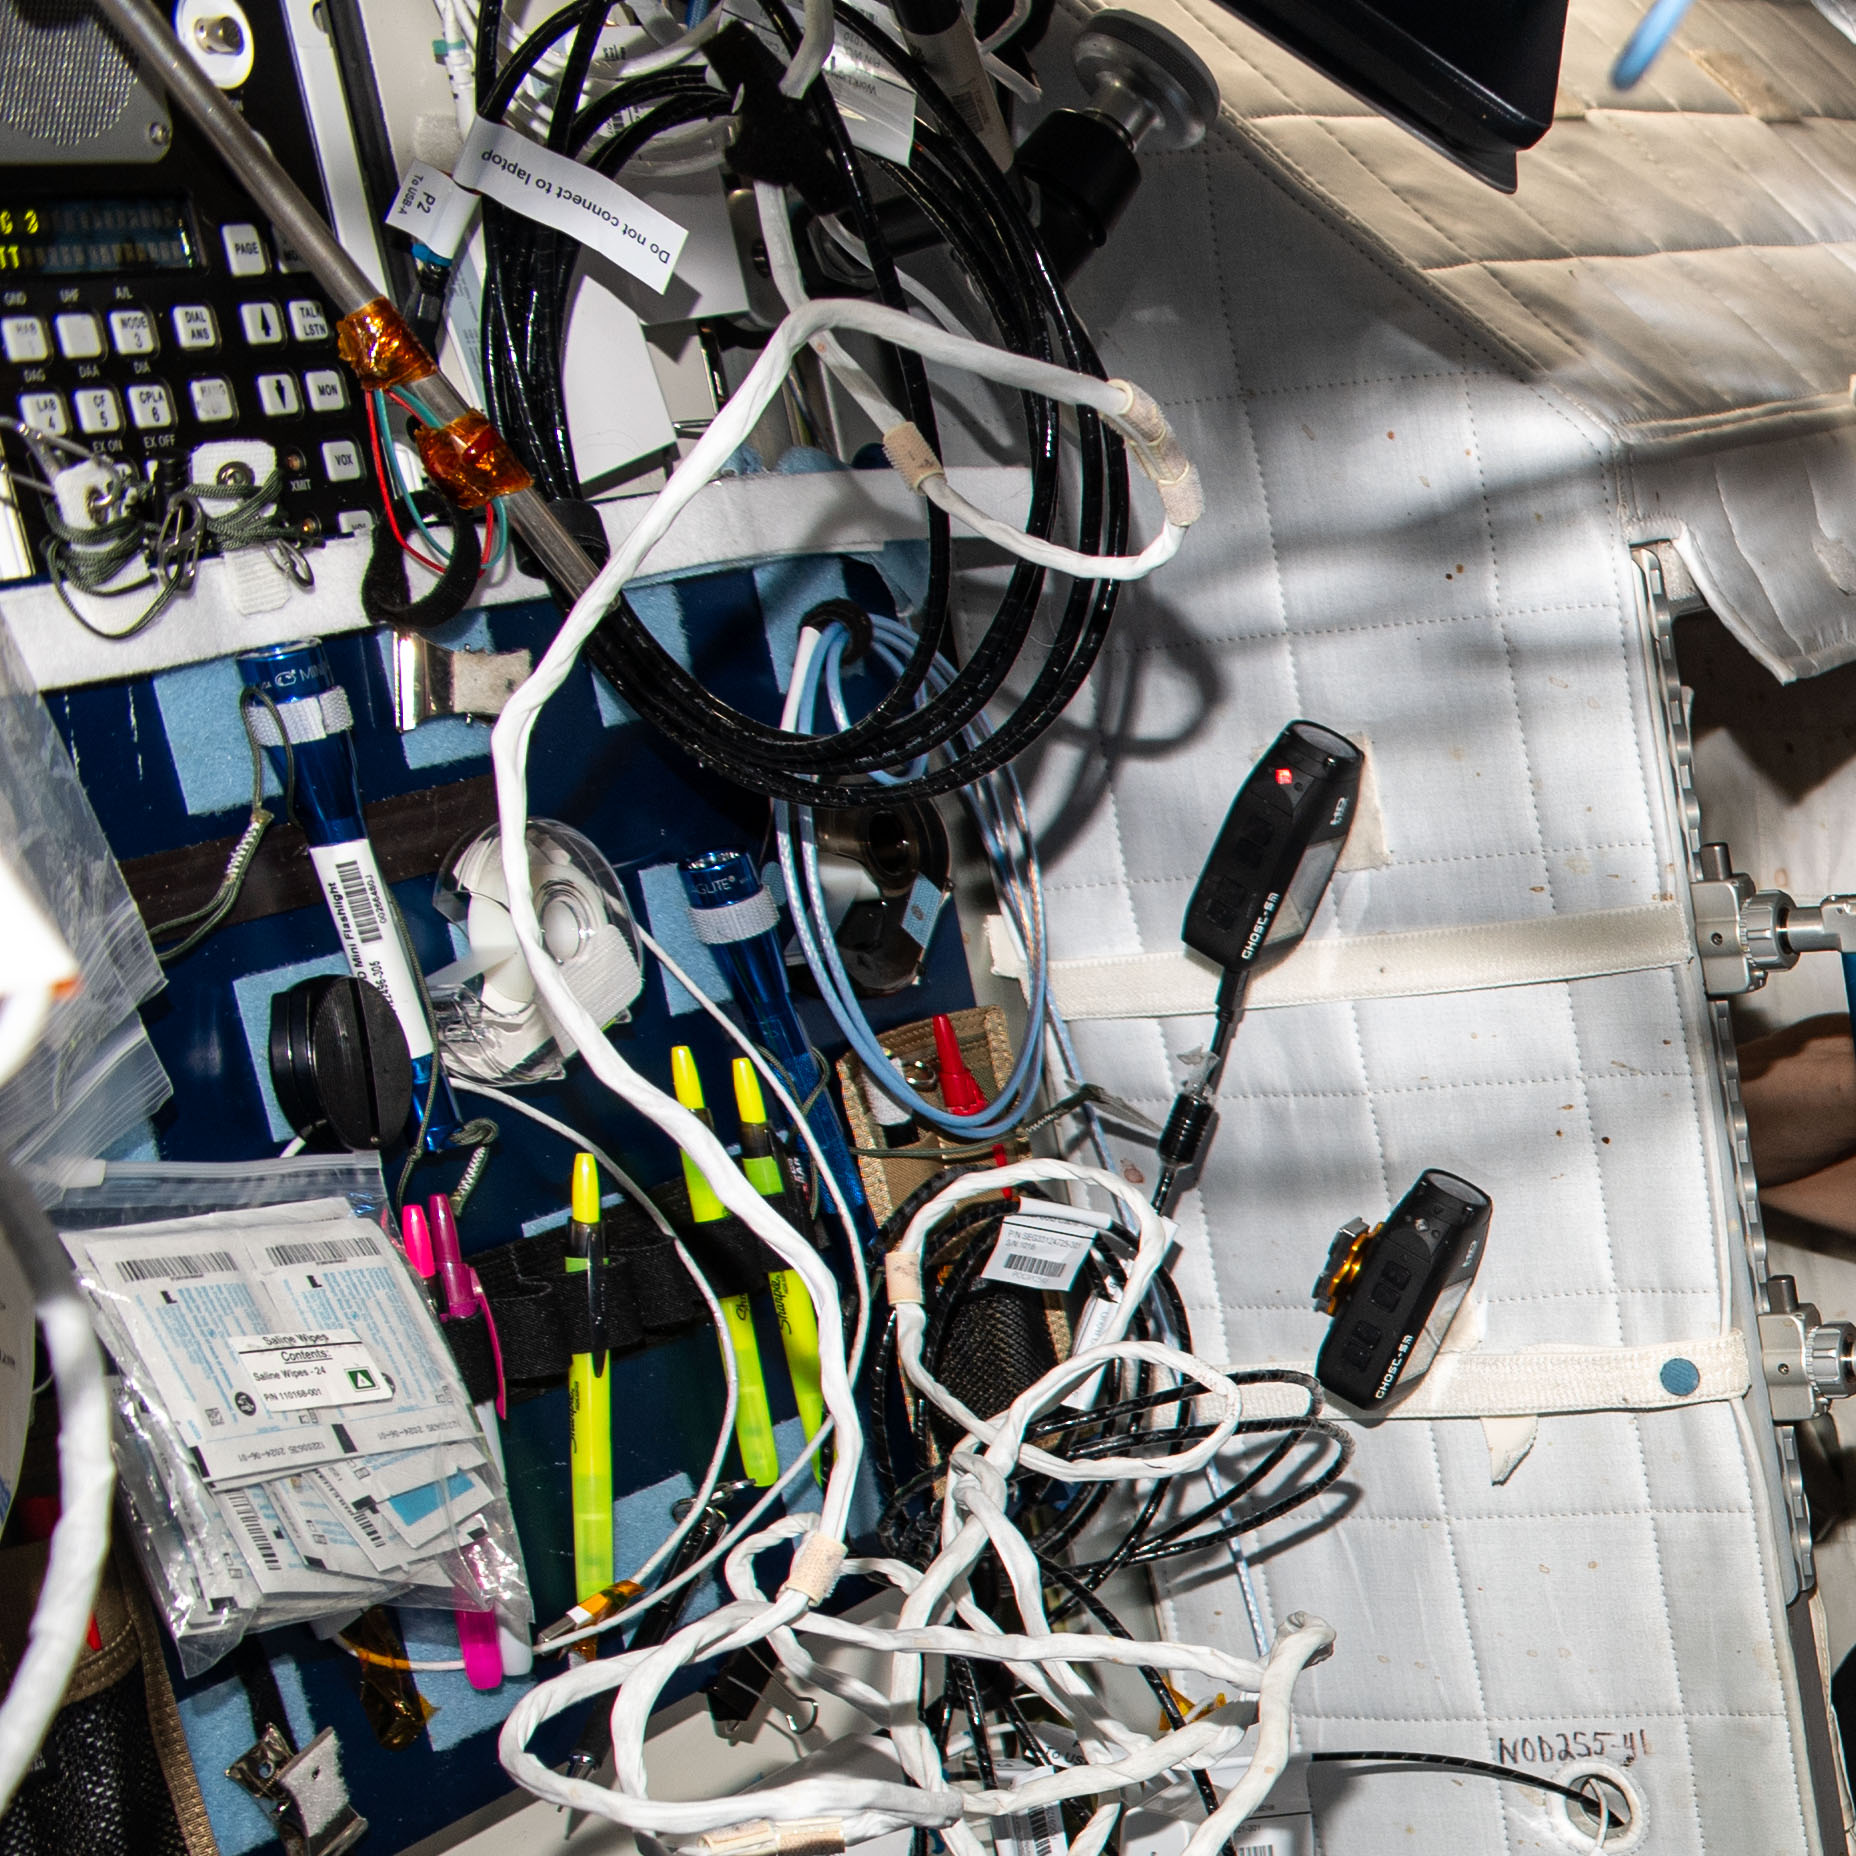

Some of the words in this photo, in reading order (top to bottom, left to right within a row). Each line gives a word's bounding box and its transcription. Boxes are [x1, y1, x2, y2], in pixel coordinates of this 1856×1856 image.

[481, 149, 531, 182] laptop
[535, 177, 553, 195] to
[417, 191, 436, 214] P2
[556, 186, 620, 227] connect
[621, 223, 646, 245] not
[234, 241, 259, 257] PAGE
[650, 243, 671, 264] Do
[190, 327, 211, 342] ANS
[317, 382, 339, 397] MON
[48, 414, 56, 430] 4
[100, 410, 109, 426] 5
[334, 453, 354, 467] VOX
[328, 882, 355, 941] Flashlight
[346, 944, 363, 969] Mini
[262, 1334, 295, 1347] Saline
[296, 1332, 330, 1345] Wipes
[281, 1348, 330, 1362] Contents:
[253, 1370, 283, 1382] Saline
[283, 1368, 308, 1379] Wipes
